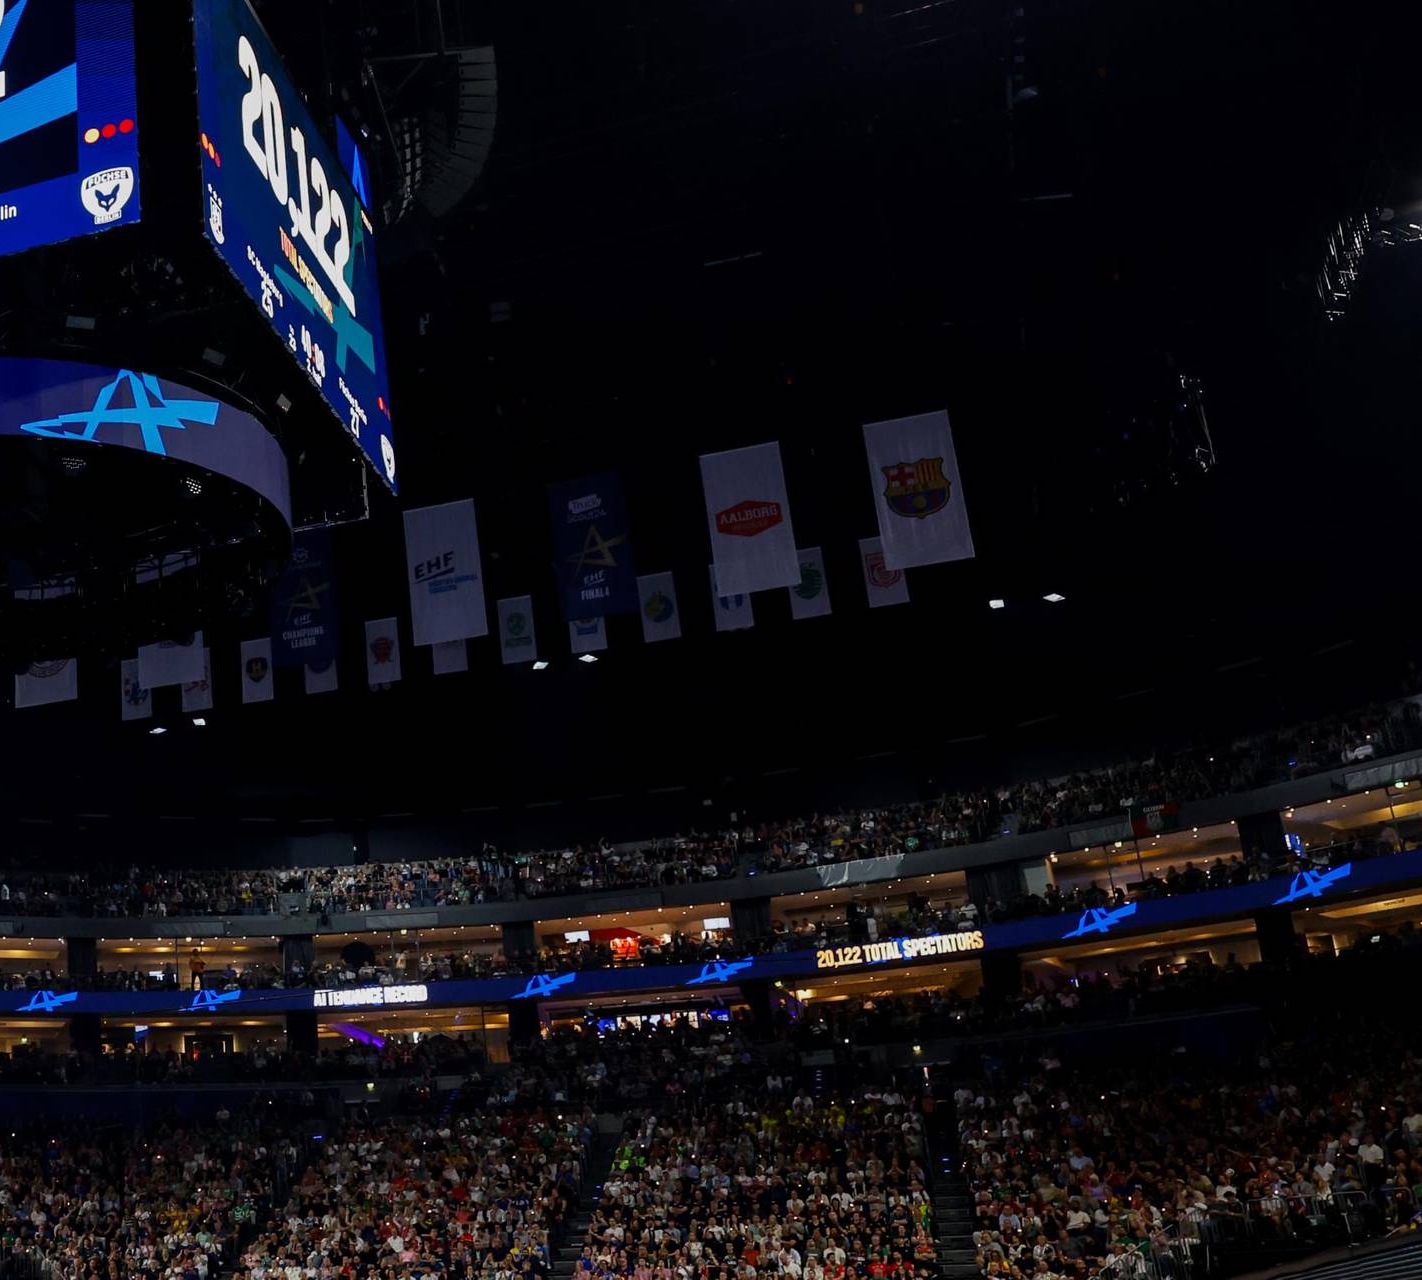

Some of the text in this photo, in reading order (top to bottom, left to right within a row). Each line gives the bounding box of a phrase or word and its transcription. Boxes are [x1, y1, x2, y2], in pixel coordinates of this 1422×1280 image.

[238, 35, 356, 317] 20,122
[720, 504, 778, 525] AALBORG
[415, 551, 454, 580] EHF
[816, 931, 984, 969] 20,122 TOTAL SPECTATORS
